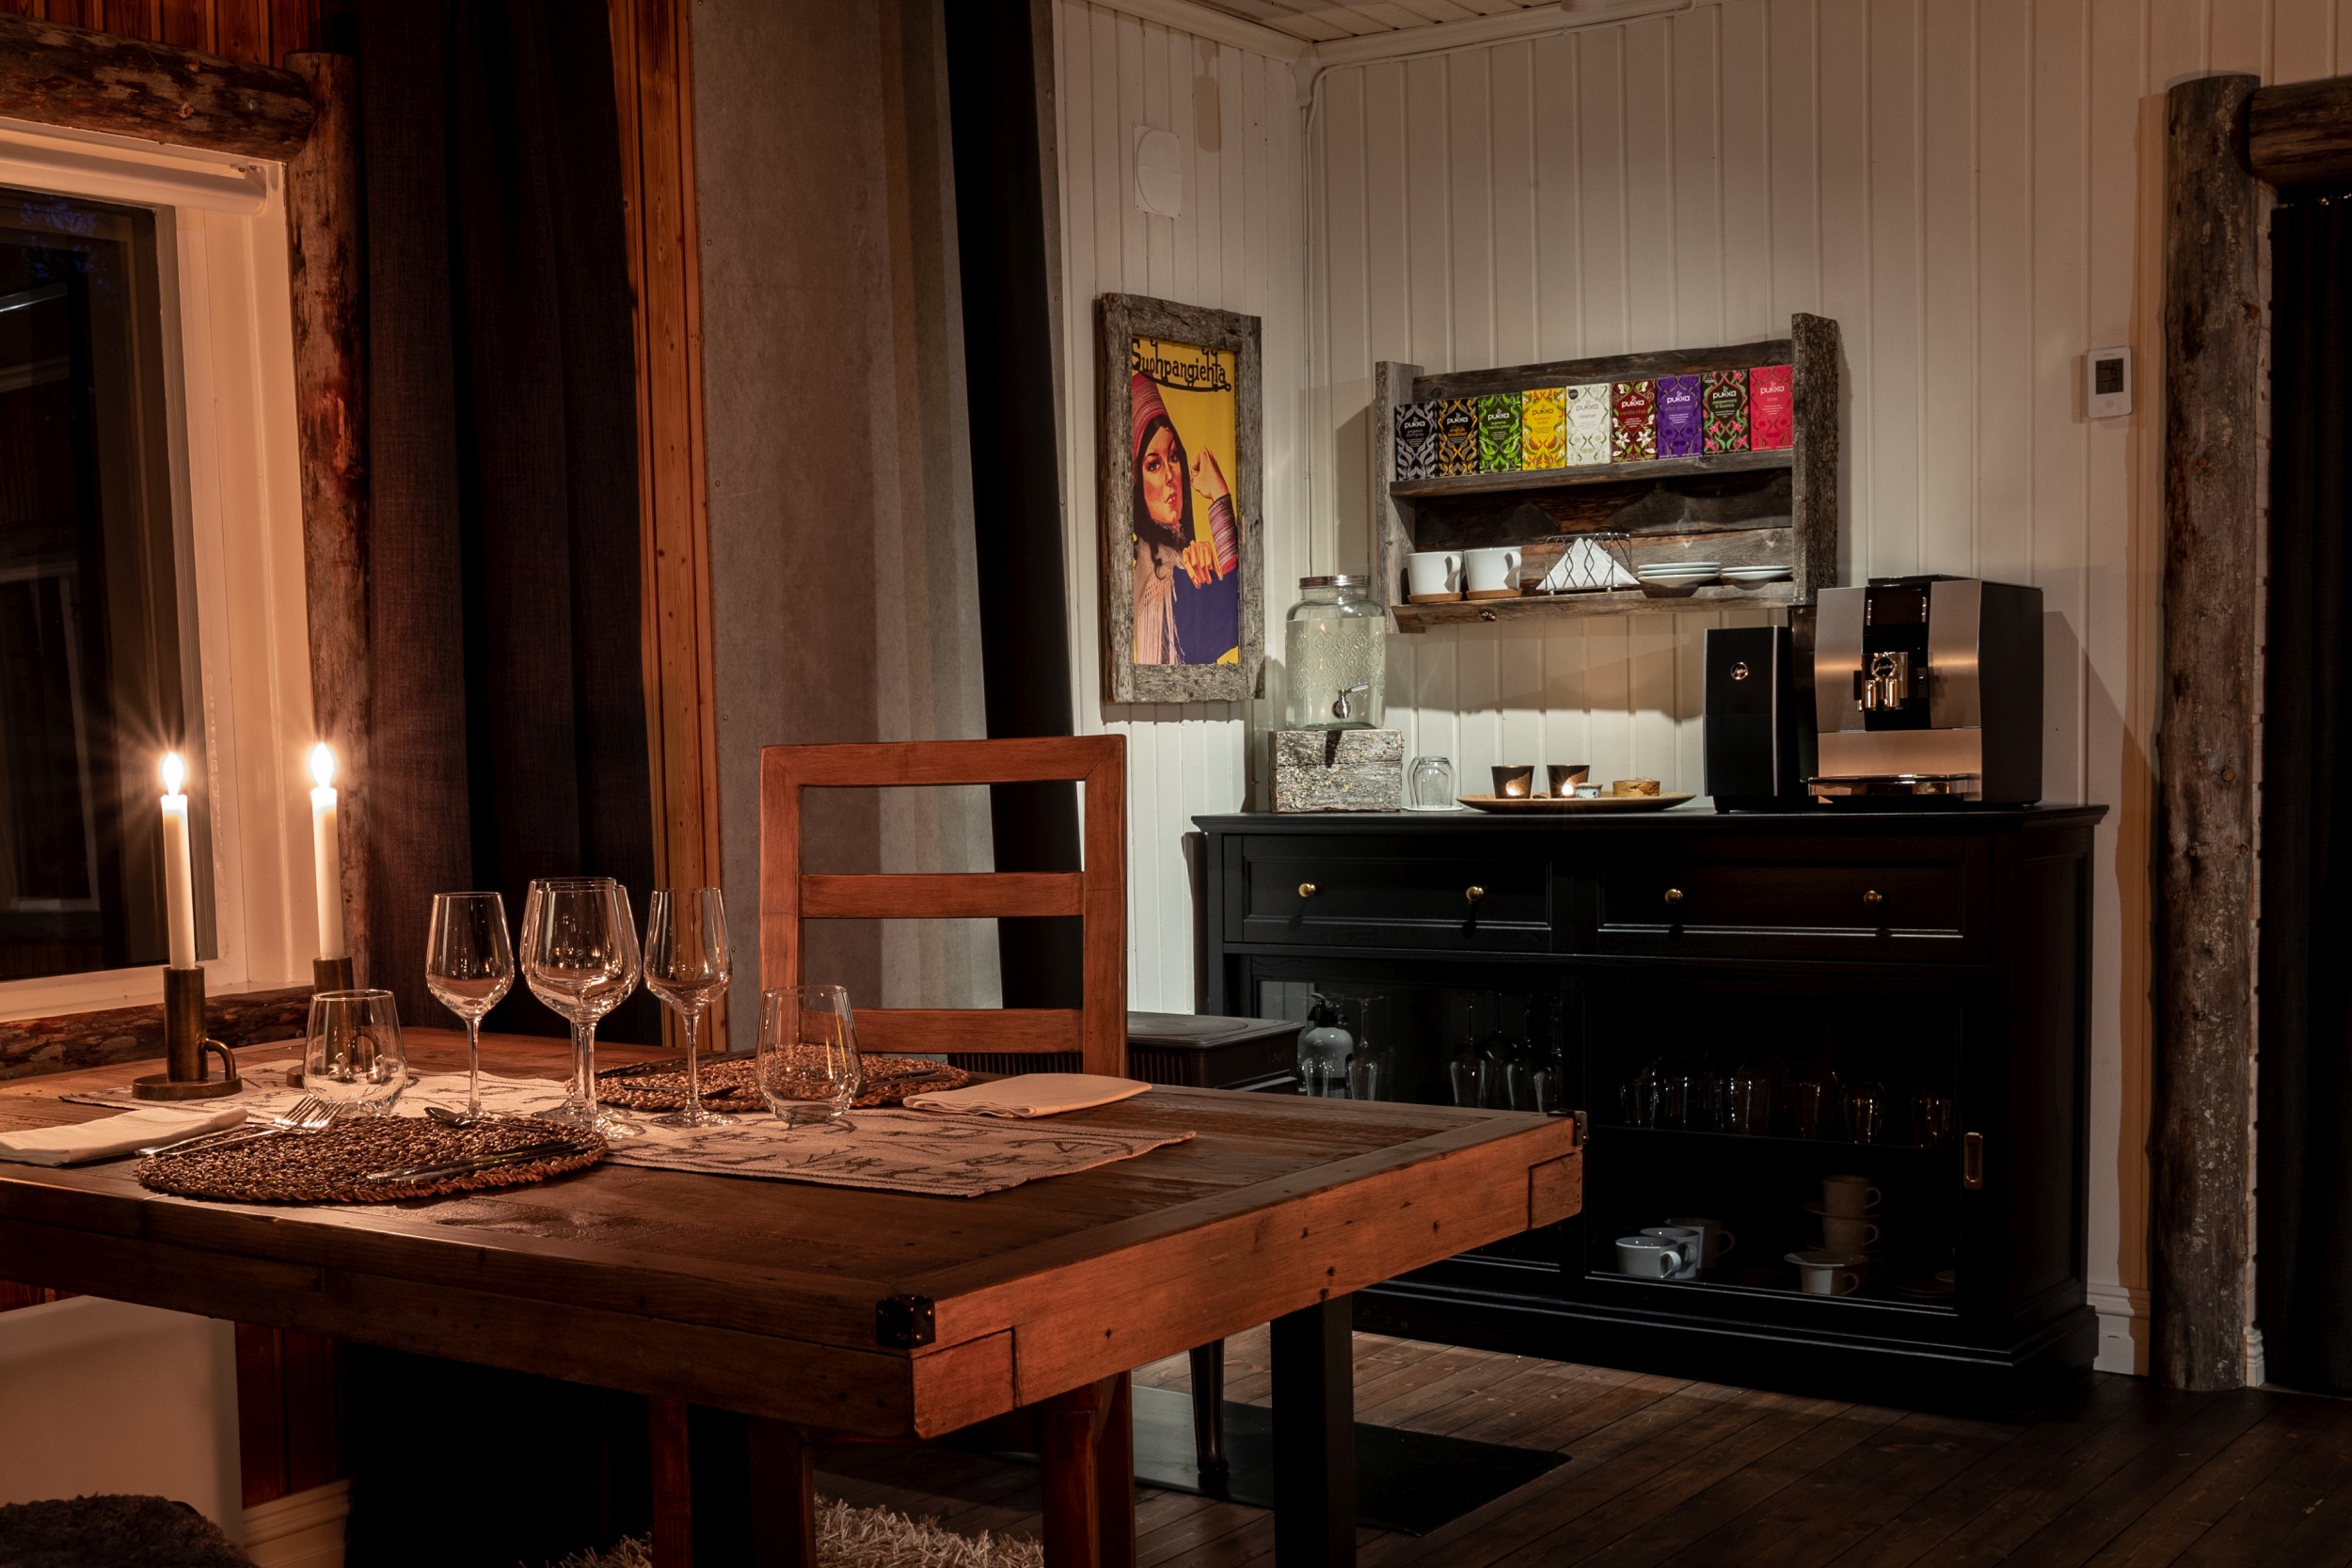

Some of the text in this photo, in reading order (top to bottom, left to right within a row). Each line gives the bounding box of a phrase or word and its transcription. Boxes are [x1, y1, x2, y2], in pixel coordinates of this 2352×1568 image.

[1131, 338, 1228, 388] Suohpangiehta
[1712, 390, 1737, 400] pukka
[1760, 386, 1785, 395] pukka
[1621, 399, 1645, 408] pukka
[1666, 395, 1691, 404] pukka
[1576, 404, 1598, 412] pukka
[1446, 417, 1469, 425] pukka
[1487, 413, 1510, 421] pukka
[1404, 420, 1426, 430] pukka
